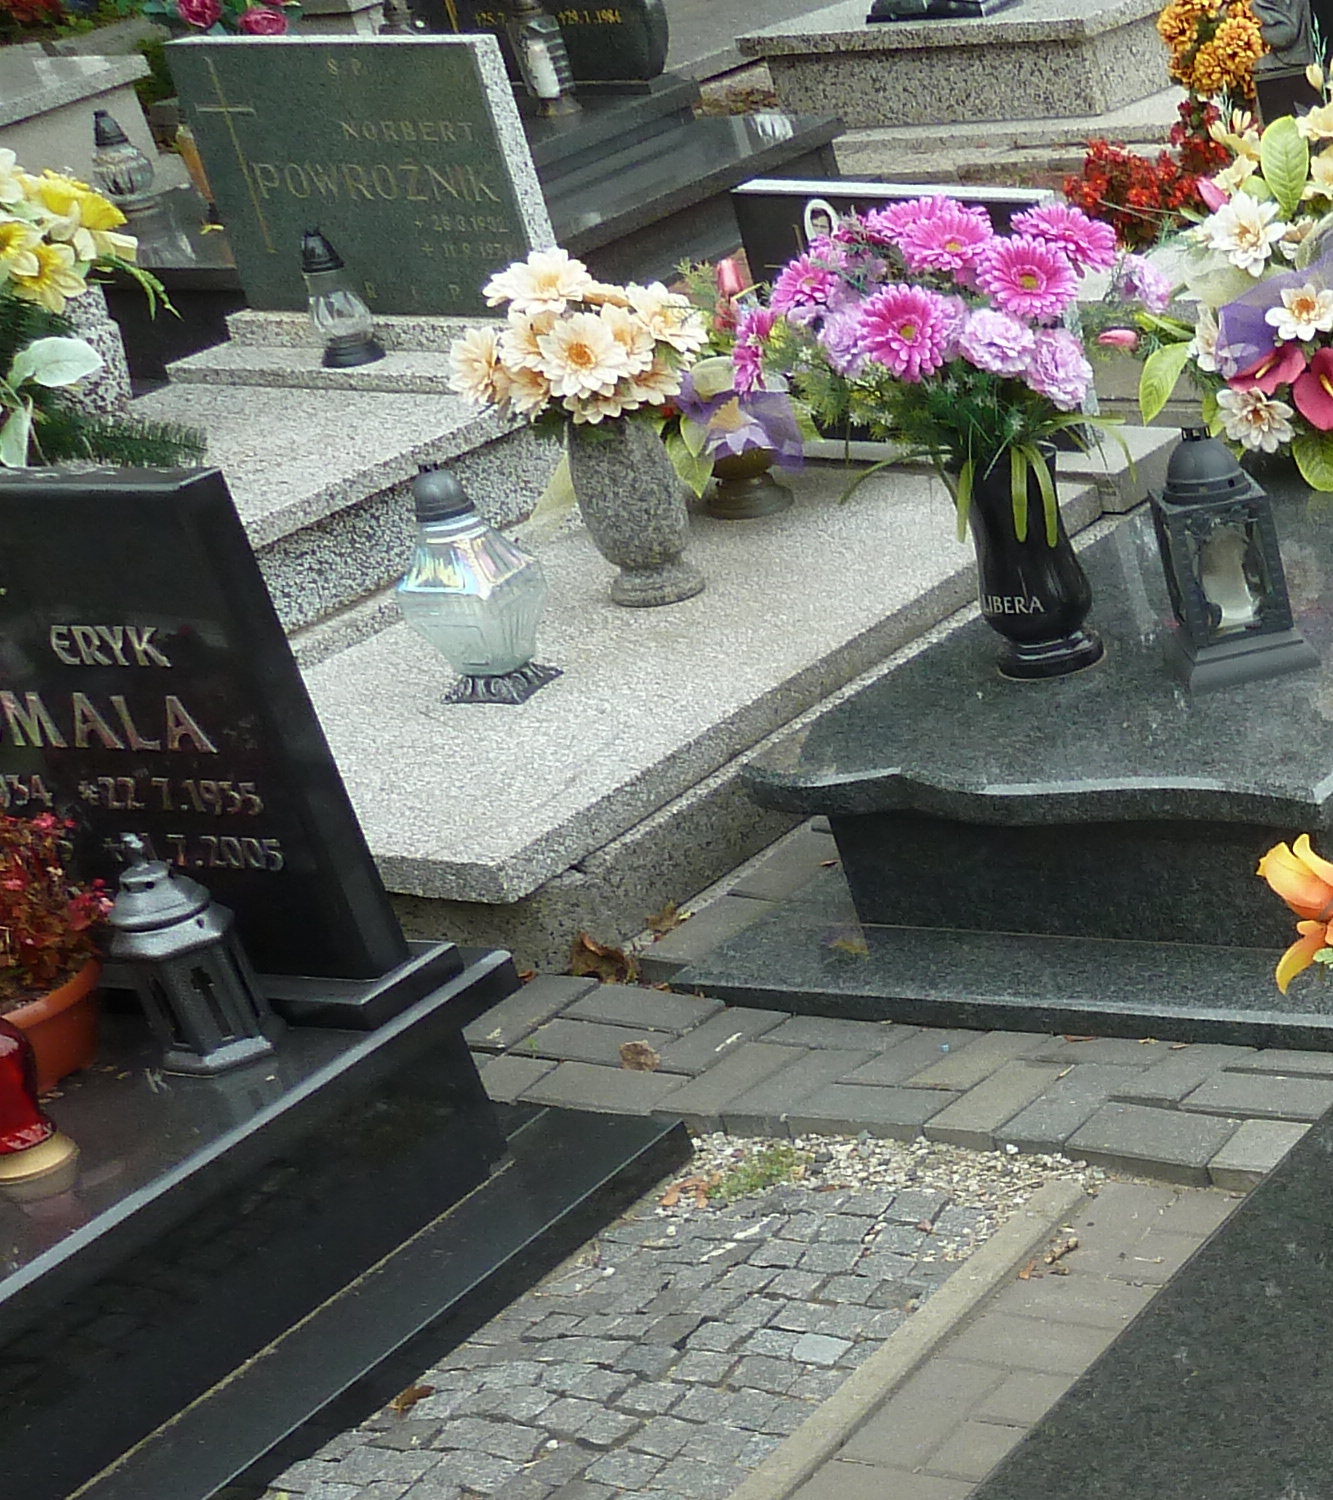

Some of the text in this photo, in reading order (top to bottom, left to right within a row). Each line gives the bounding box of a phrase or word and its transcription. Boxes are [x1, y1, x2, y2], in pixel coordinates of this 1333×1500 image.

[339, 120, 474, 143] NORBERT
[982, 594, 1046, 614] LIBERA
[50, 624, 173, 668] ERYK
